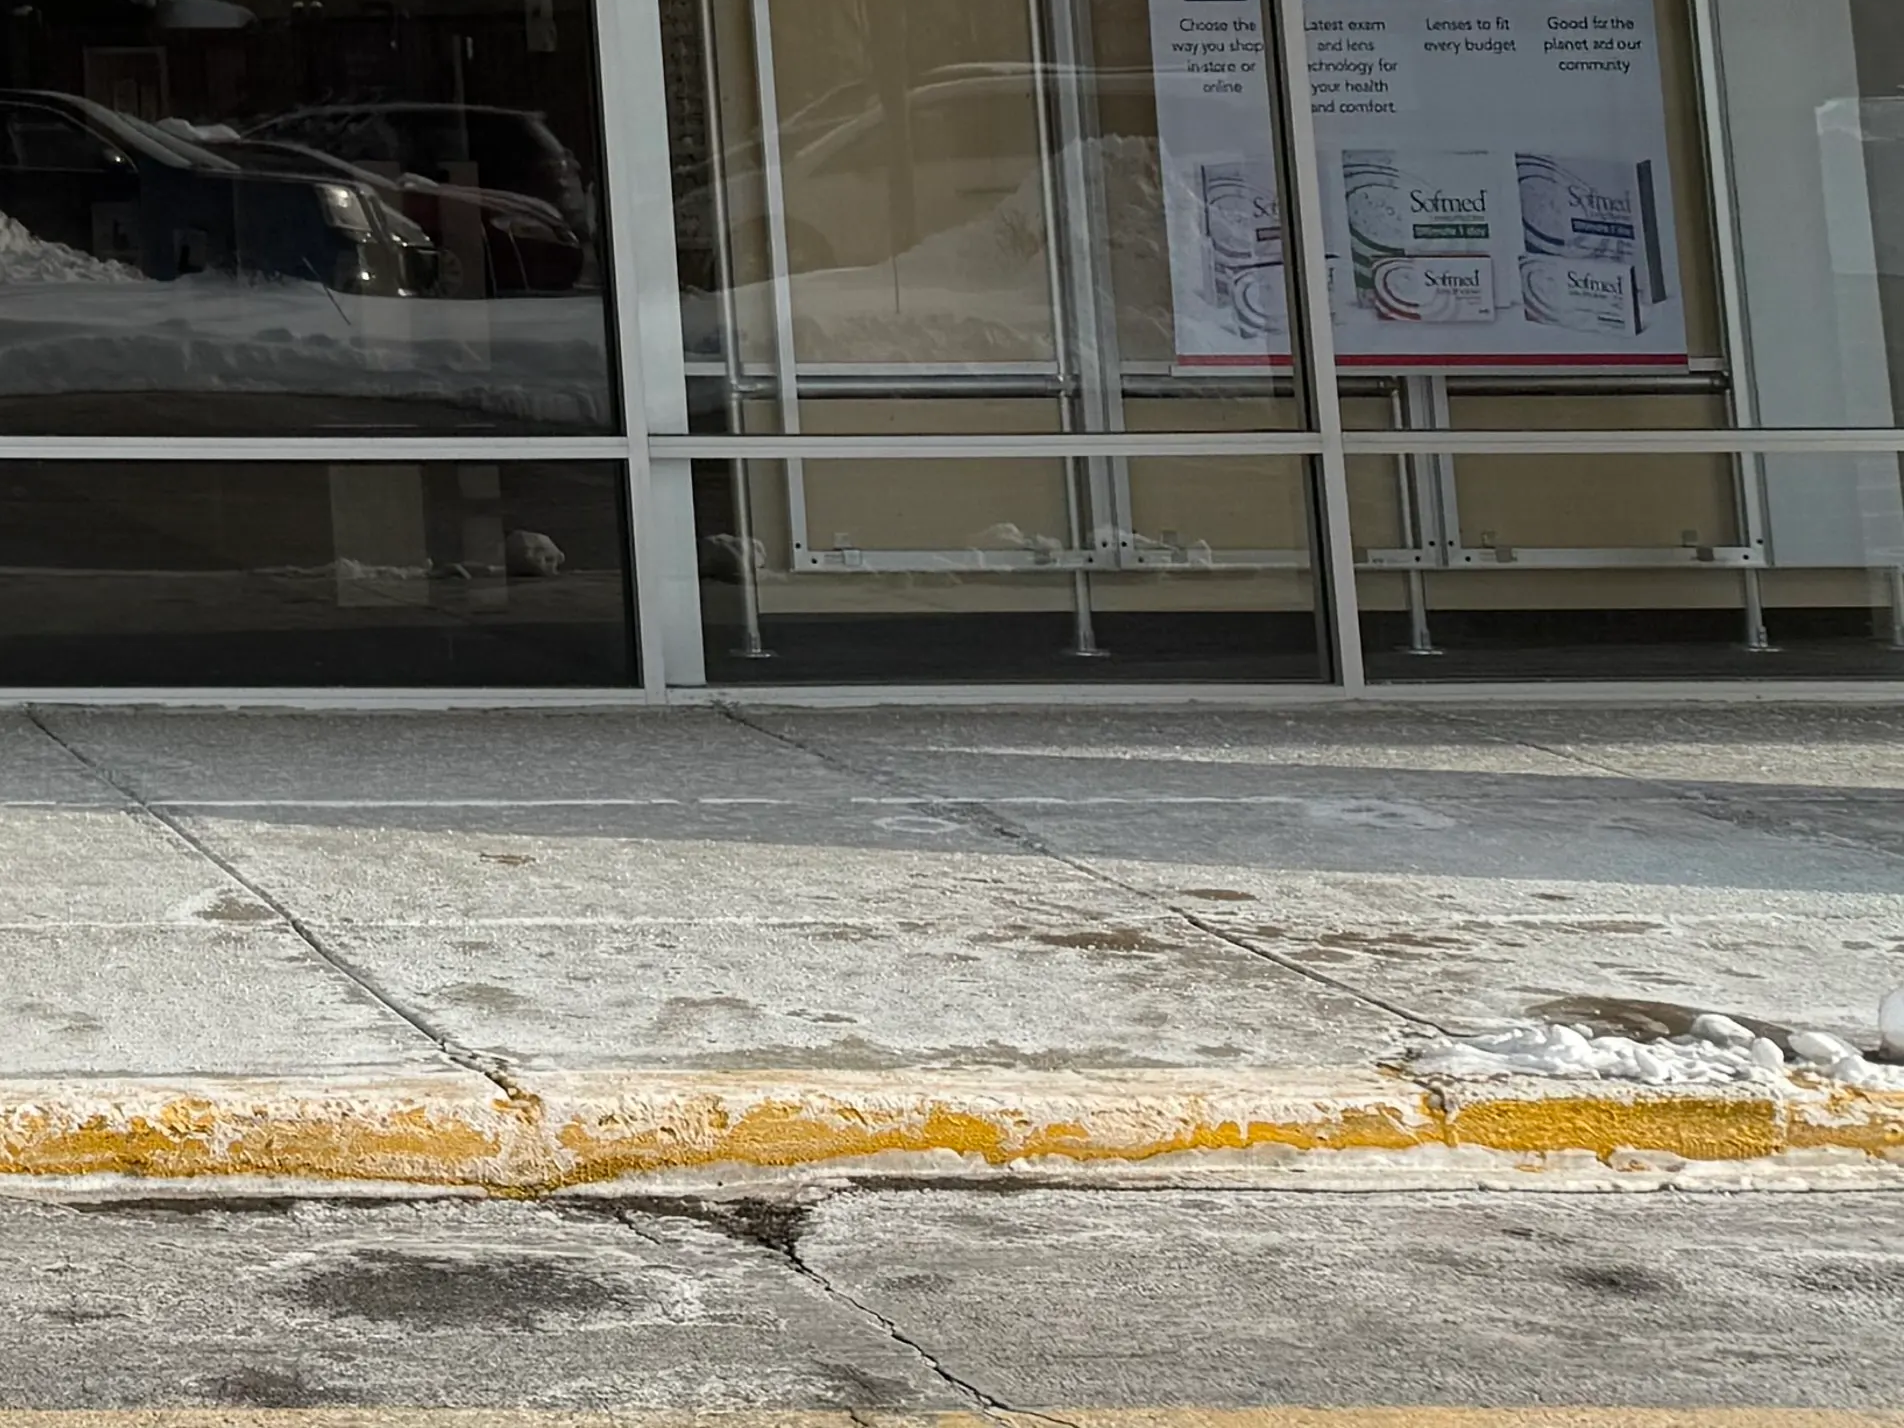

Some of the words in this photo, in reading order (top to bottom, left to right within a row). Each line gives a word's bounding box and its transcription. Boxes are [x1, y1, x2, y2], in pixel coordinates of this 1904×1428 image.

[1178, 17, 1228, 32] Choose
[1233, 17, 1257, 32] the
[1304, 20, 1344, 32] Latest
[1348, 20, 1387, 32] exam
[1425, 17, 1473, 31] Lenses
[1476, 18, 1492, 31] to
[1495, 16, 1510, 31] fit
[1547, 16, 1588, 31] Good
[1592, 15, 1608, 31] for
[1610, 15, 1635, 31] the
[1171, 41, 1198, 56] way
[1201, 41, 1225, 56] you
[1229, 37, 1265, 56] shop
[1317, 37, 1343, 52] and
[1347, 37, 1375, 52] lens
[1423, 41, 1461, 55] every
[1464, 37, 1516, 55] budget
[1543, 37, 1589, 54] planet
[1592, 37, 1614, 52] and
[1616, 39, 1642, 52] our
[1240, 61, 1257, 73] or
[1307, 58, 1374, 76] chnology
[1378, 57, 1399, 73] for
[1558, 58, 1631, 75] community
[1202, 79, 1243, 94] online
[1311, 82, 1341, 97] your
[1344, 79, 1389, 93] health
[1409, 189, 1487, 214] Sofmed
